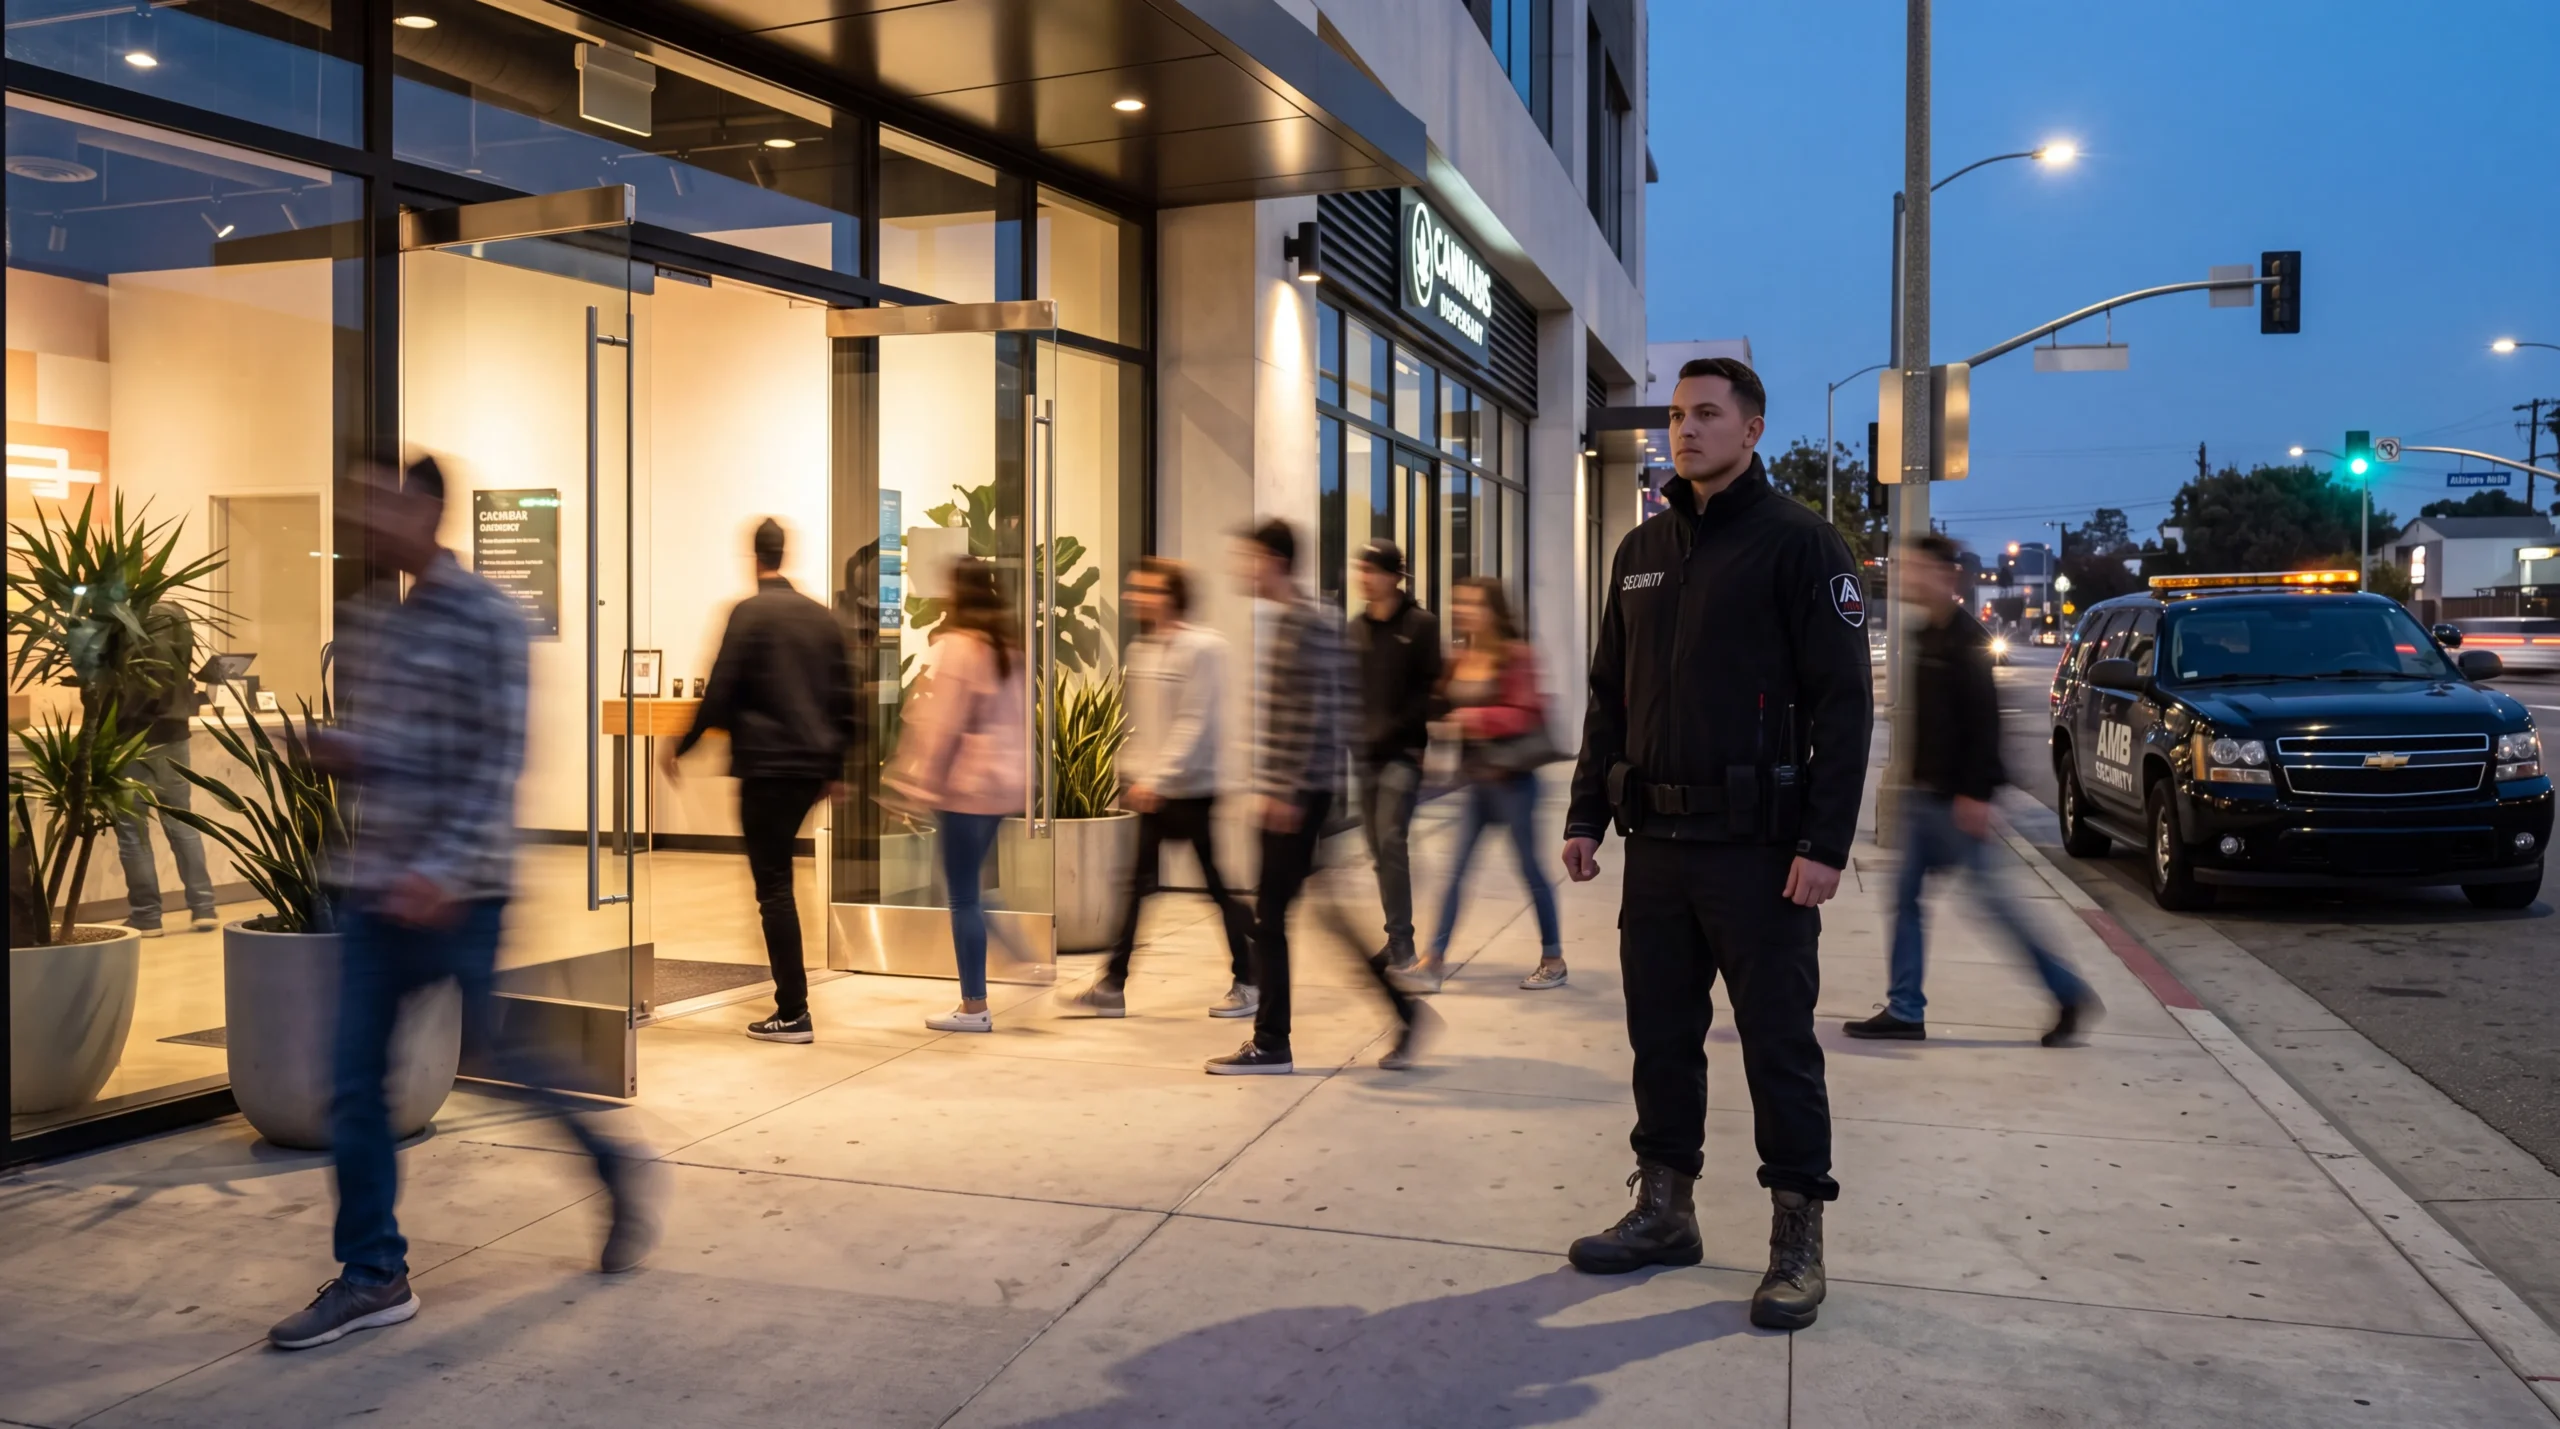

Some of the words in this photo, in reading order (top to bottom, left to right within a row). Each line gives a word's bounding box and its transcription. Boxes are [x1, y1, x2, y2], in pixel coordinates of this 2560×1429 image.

[1433, 227, 1492, 318] CANNABIS
[1622, 571, 1665, 591] SECURITY
[2096, 719, 2132, 766] AMB
